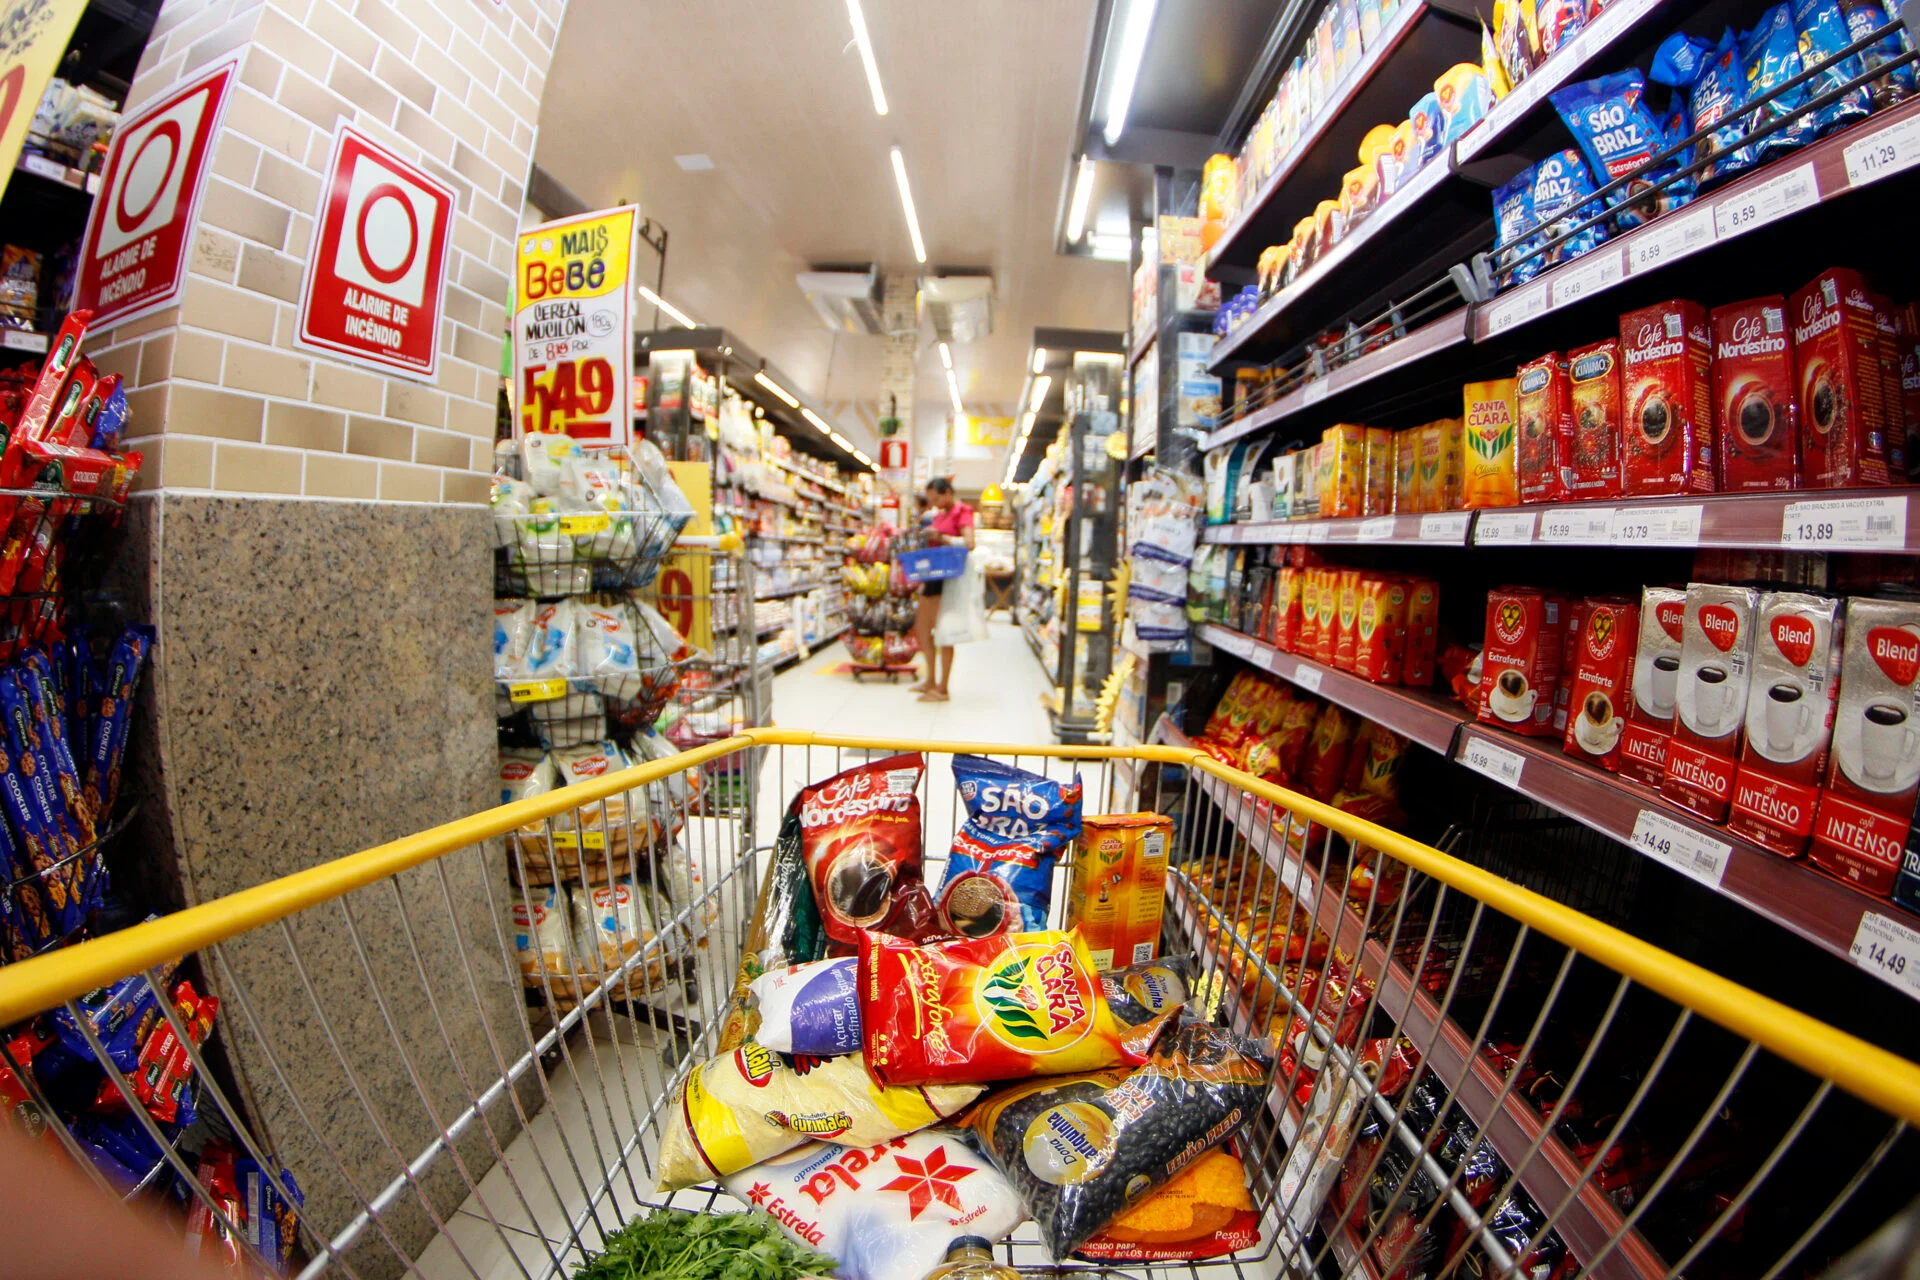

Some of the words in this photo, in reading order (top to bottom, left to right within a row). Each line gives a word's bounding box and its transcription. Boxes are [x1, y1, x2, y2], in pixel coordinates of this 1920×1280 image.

[1588, 103, 1625, 133] SÃO
[1592, 123, 1644, 156] BRAZ
[1609, 155, 1652, 174] Extraforte
[1862, 145, 1896, 171] 11,29
[1732, 205, 1756, 226] 8,59
[561, 224, 608, 258] MAIS
[1640, 244, 1660, 262] 8,59
[100, 244, 141, 280] ALARME
[140, 235, 158, 261] DE
[99, 267, 147, 306] INCÊNDIO
[343, 287, 392, 322] ALARME
[392, 303, 409, 327] DE
[1803, 292, 1822, 324] Café
[345, 315, 403, 349] INCÊNDIO
[1638, 323, 1662, 348] Café
[1732, 316, 1761, 342] Café
[1795, 310, 1841, 346] Nordestino
[1626, 341, 1683, 365] Nordestino
[1718, 335, 1785, 360] Nordestino
[1468, 411, 1511, 427] CLARA
[1472, 400, 1506, 413] SANTA
[1622, 525, 1648, 539] 13,79
[1798, 523, 1833, 542] 13,89
[1662, 608, 1684, 625] Blen
[1705, 613, 1735, 633] Blend
[1777, 625, 1812, 646] Blend
[1877, 637, 1919, 663] Blend
[1488, 652, 1525, 667] Extraforte
[1579, 669, 1612, 688] Extraforte
[98, 720, 111, 762] COOKIES
[1629, 738, 1667, 763] INTEN
[818, 772, 871, 806] Café
[1671, 757, 1727, 793] INTENSO
[8, 772, 32, 822] COOKIES
[34, 775, 53, 824] COOKIES
[981, 783, 1050, 820] SÃO
[1738, 786, 1800, 825] INTENSO
[952, 834, 1033, 860] Extraforte
[1643, 831, 1671, 855] 14,49
[1826, 816, 1902, 863] INTENSO
[1853, 942, 1862, 955] R$
[1868, 941, 1906, 976] 14,49
[909, 947, 954, 1052] Extraforte
[1035, 954, 1073, 1037] CLARA
[1055, 949, 1087, 1026] SANTA
[832, 1008, 847, 1047] Açúcar
[1050, 1138, 1078, 1165] Dona
[1165, 1137, 1206, 1175] FEIJÃO
[1206, 1108, 1242, 1144] PRETO
[793, 1143, 844, 1184] Granulado
[766, 1197, 825, 1247] Estrela
[1215, 1230, 1240, 1241] Peso
